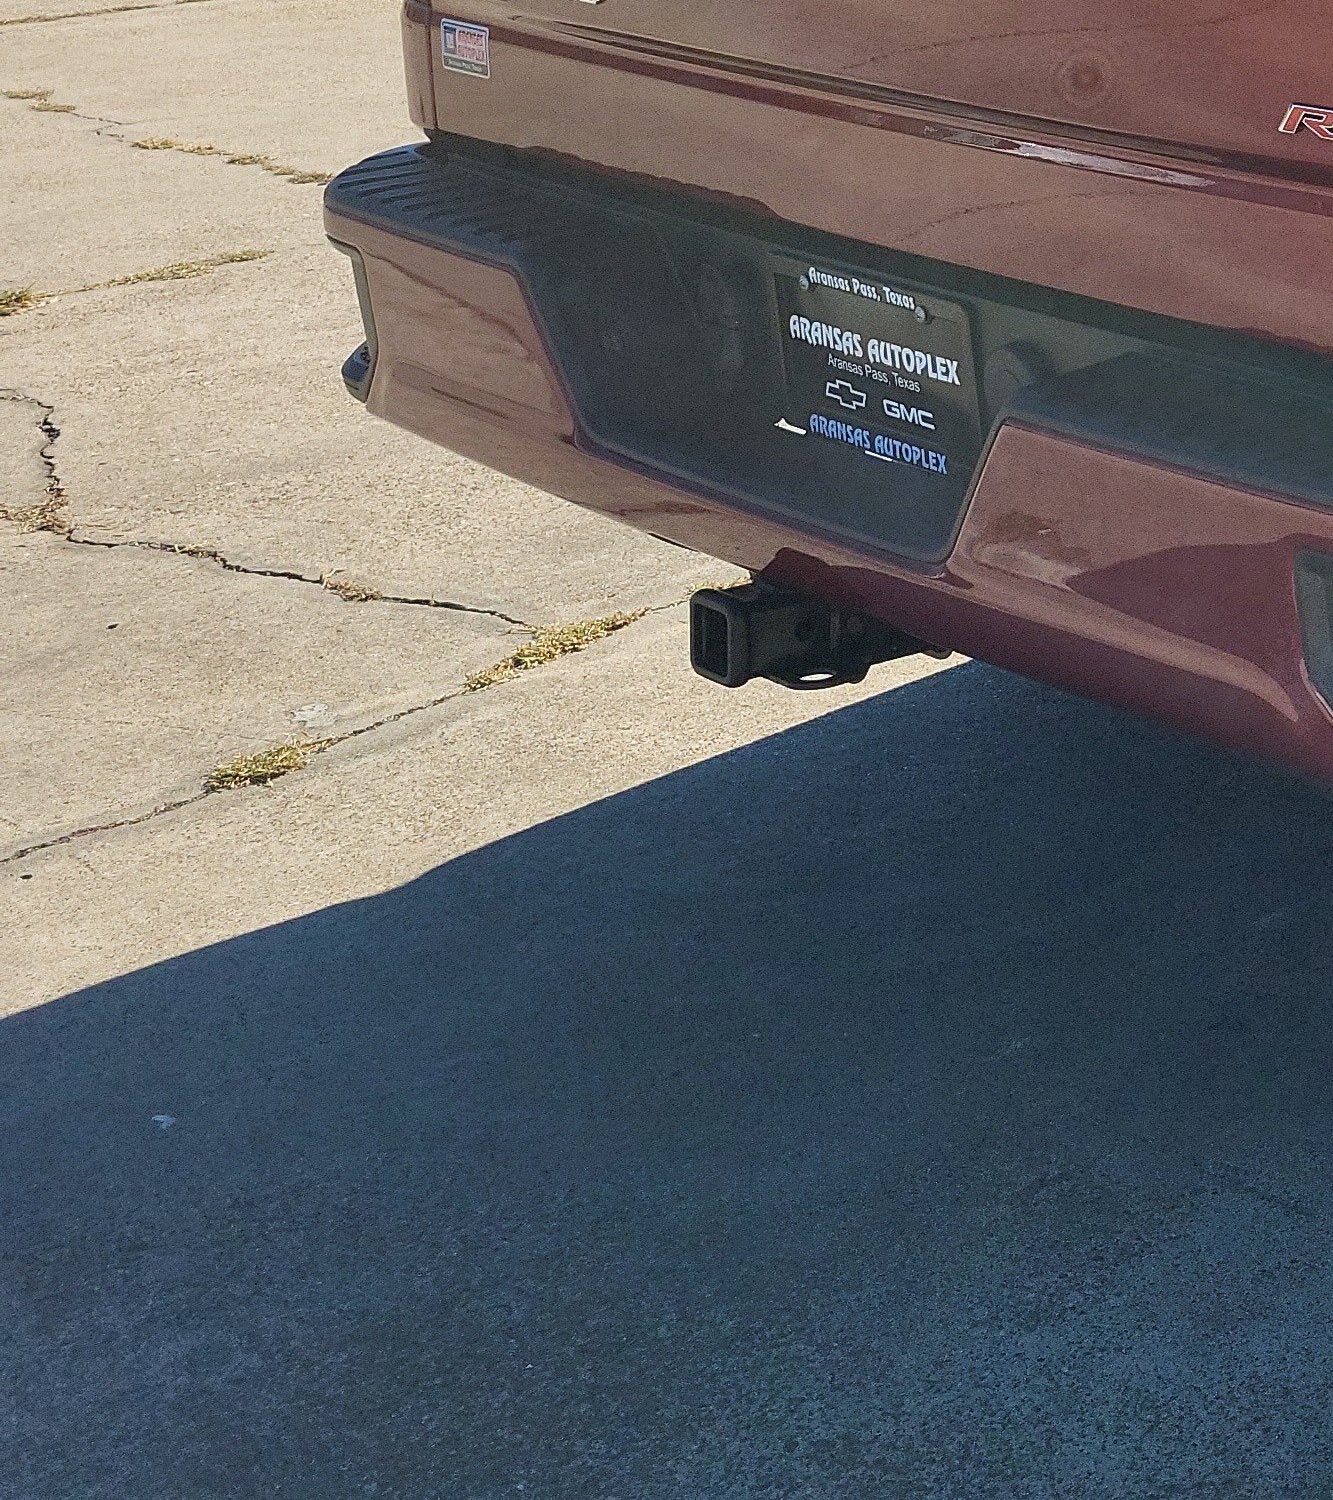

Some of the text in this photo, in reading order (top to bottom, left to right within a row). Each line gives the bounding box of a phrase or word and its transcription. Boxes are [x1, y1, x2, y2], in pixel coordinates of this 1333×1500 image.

[808, 266, 915, 310] Aransas Pass, Texas
[789, 314, 961, 386] ARANSAS AUTOPLEX
[828, 353, 921, 392] Aransas Pass, Texas
[883, 399, 936, 430] GMC
[809, 413, 948, 475] ARANSAS AUTOPLEX
